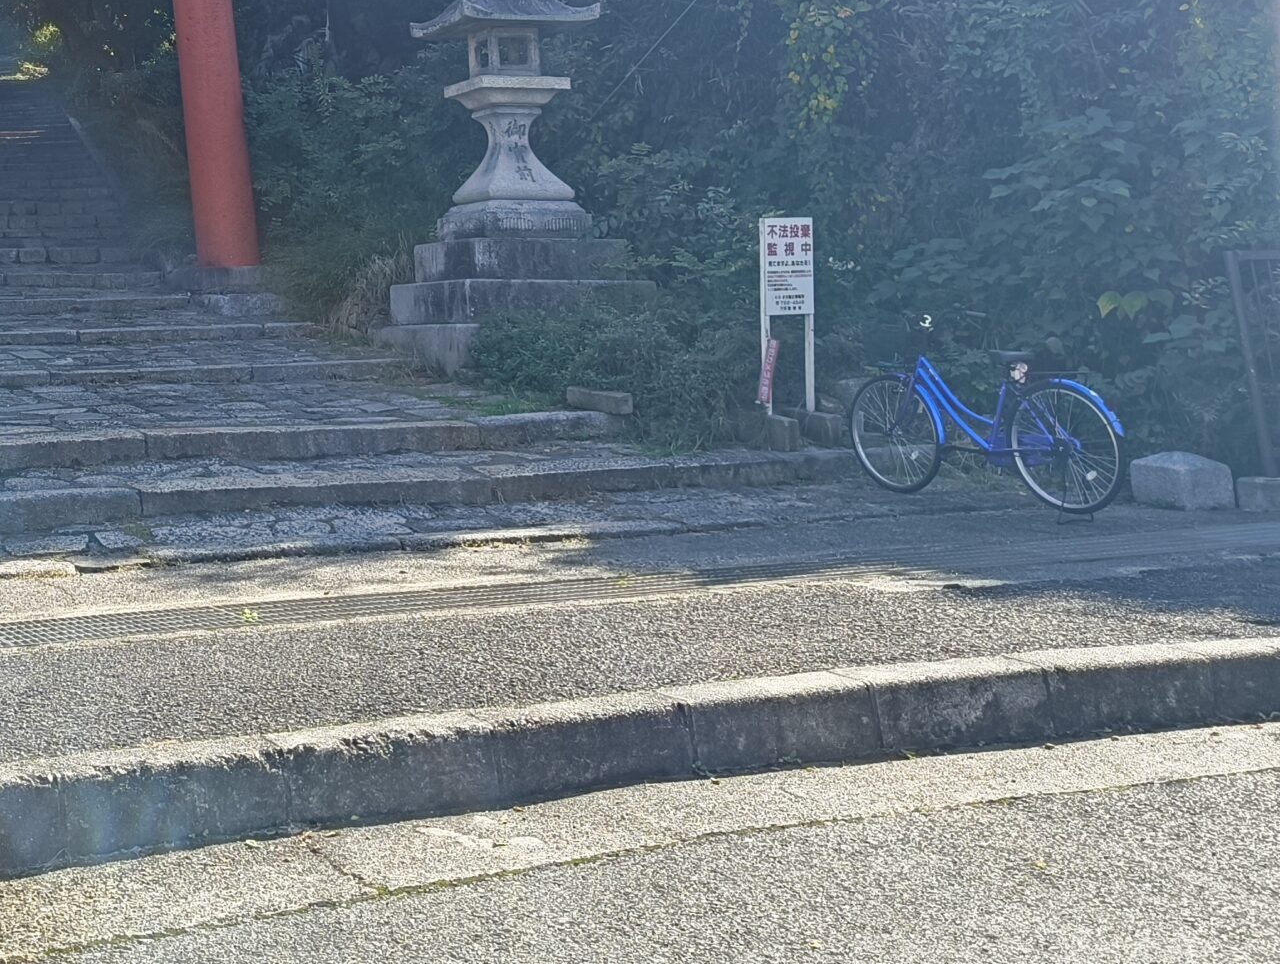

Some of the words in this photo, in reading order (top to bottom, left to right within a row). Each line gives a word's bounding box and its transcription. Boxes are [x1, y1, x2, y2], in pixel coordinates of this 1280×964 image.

[767, 224, 811, 239] 不法投棄
[767, 241, 812, 256] 監視中
